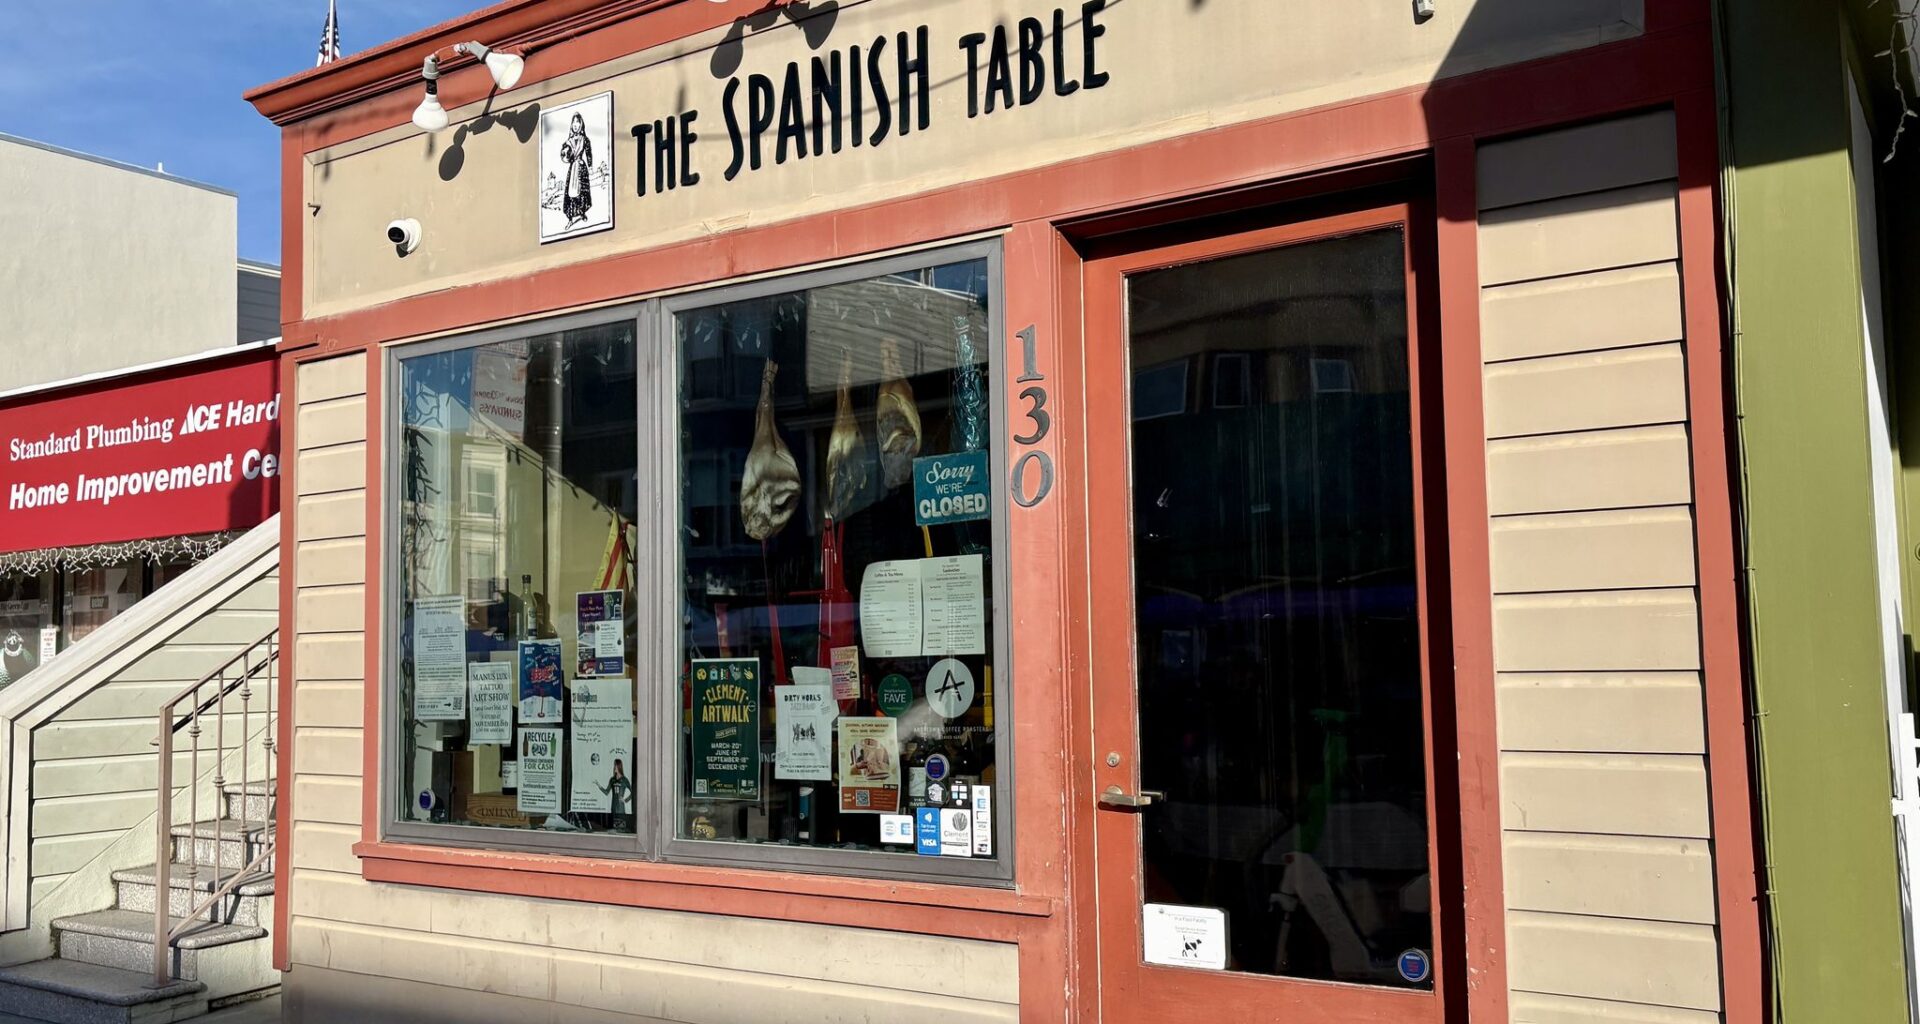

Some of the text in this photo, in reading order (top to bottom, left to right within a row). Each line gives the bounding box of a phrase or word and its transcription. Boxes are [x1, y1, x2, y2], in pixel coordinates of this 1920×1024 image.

[631, 0, 1110, 198] THE SPANISH TABLE
[1010, 324, 1055, 508] 130
[10, 428, 81, 461] Standard
[86, 416, 175, 450] Plumbing
[179, 403, 222, 435] ACE
[9, 482, 69, 510] Home
[77, 453, 233, 505] Improvement
[925, 461, 975, 486] Sorry
[935, 482, 963, 494] WE'RE
[919, 494, 988, 519] CLOSED
[474, 693, 510, 702] ART SHOW
[705, 684, 747, 703] CLEMENT
[883, 693, 906, 703] FAVE
[702, 705, 750, 723] ARTWALK
[528, 732, 552, 743] RECYCLE
[921, 838, 937, 846] VISA
